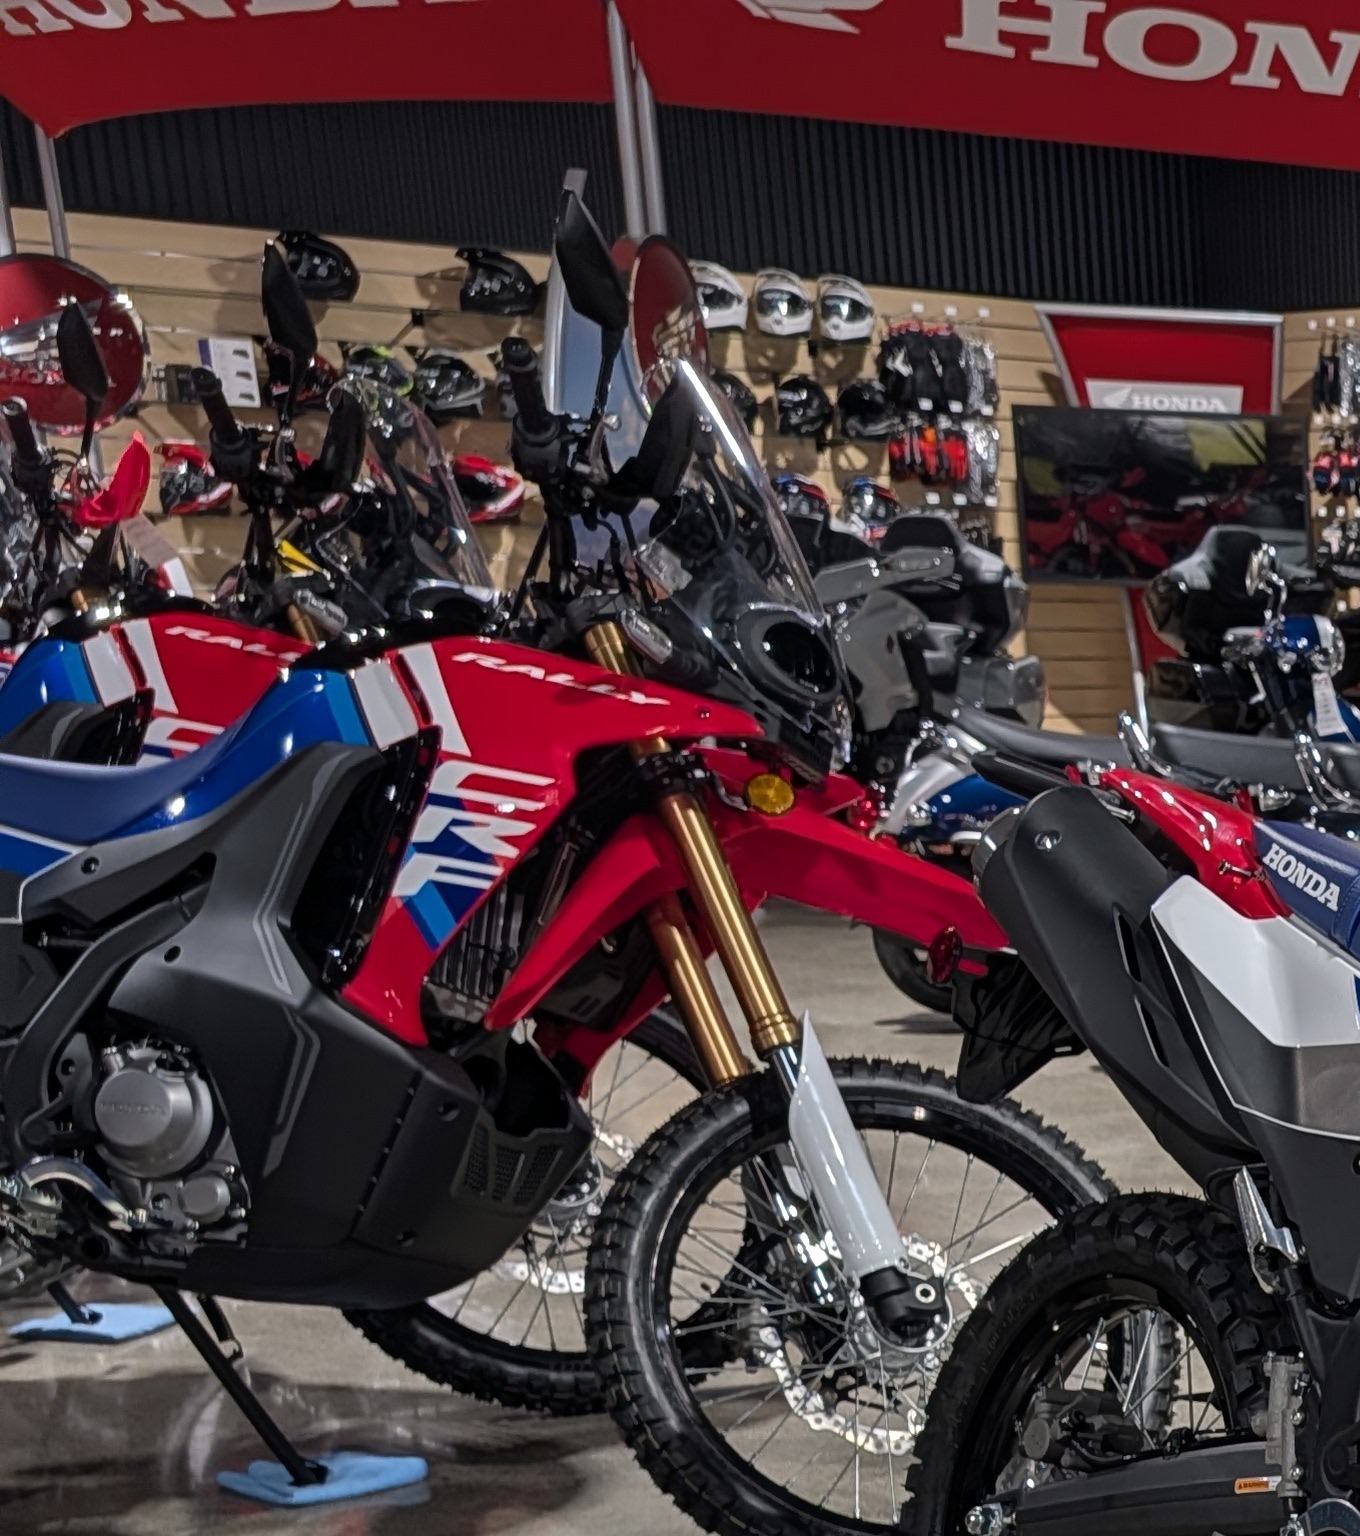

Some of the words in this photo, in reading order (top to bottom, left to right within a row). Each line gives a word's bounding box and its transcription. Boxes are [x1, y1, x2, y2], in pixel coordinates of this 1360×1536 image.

[1131, 394, 1227, 412] HONDA
[164, 625, 302, 662] RALL
[451, 652, 671, 705] RALLY
[1262, 842, 1341, 912] HONDA
